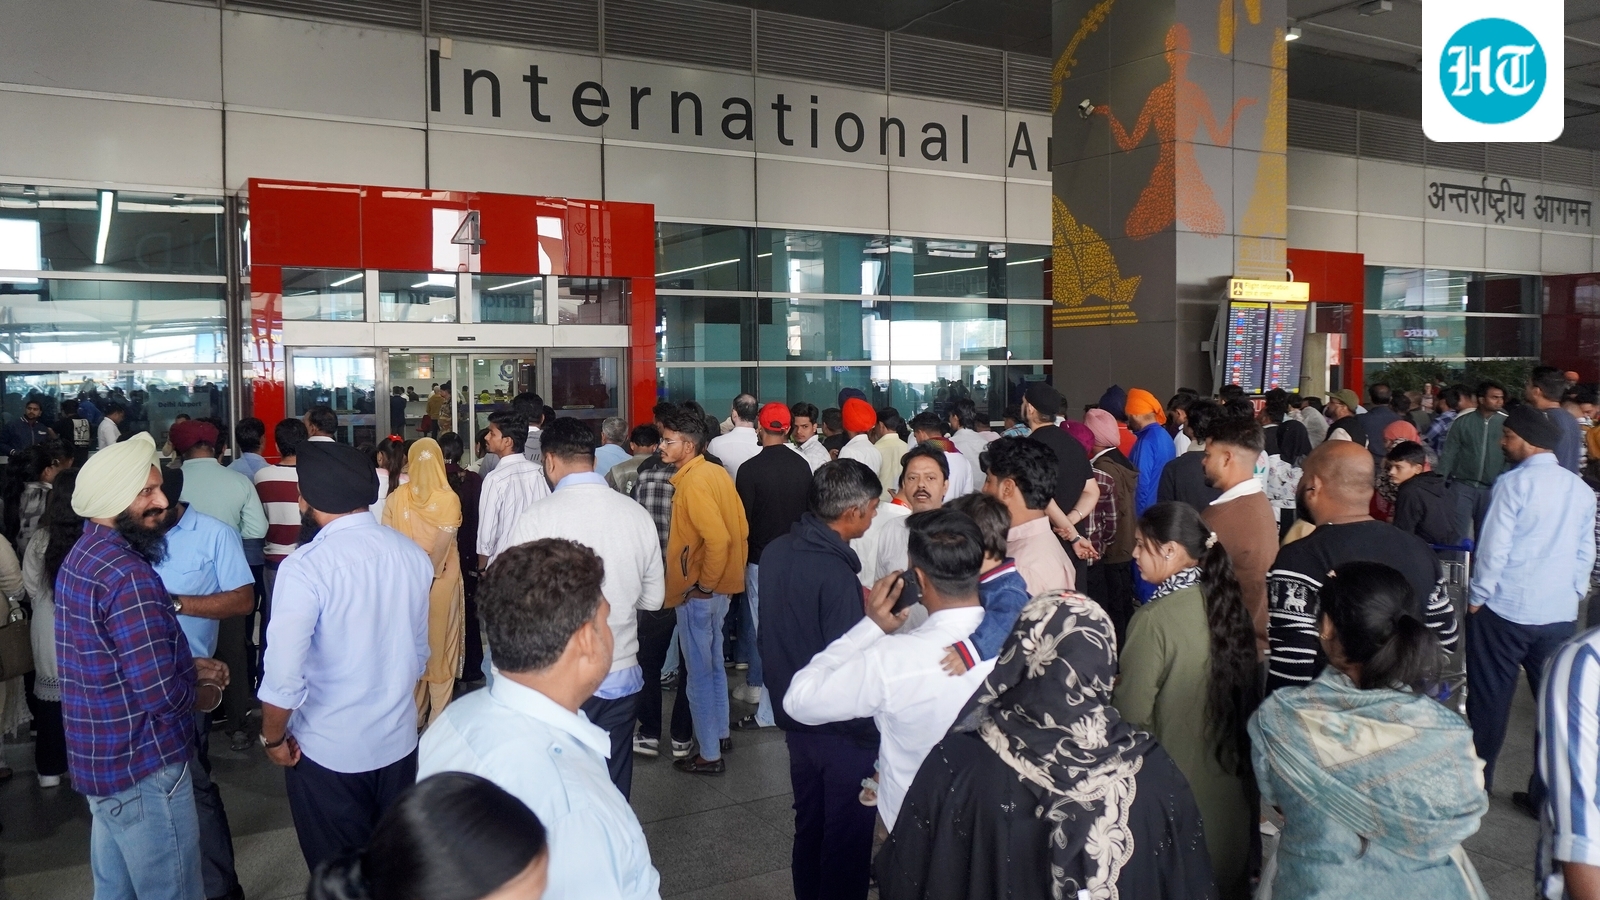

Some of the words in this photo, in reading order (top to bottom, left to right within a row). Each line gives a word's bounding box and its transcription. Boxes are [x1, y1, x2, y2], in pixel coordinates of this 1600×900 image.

[429, 49, 969, 164] International
[1008, 121, 1053, 173] A
[1428, 176, 1526, 224] अन्तर्राष्ट्रीय
[1533, 194, 1592, 227] आगमन
[450, 211, 487, 255] 4
[178, 401, 202, 409] Airport
